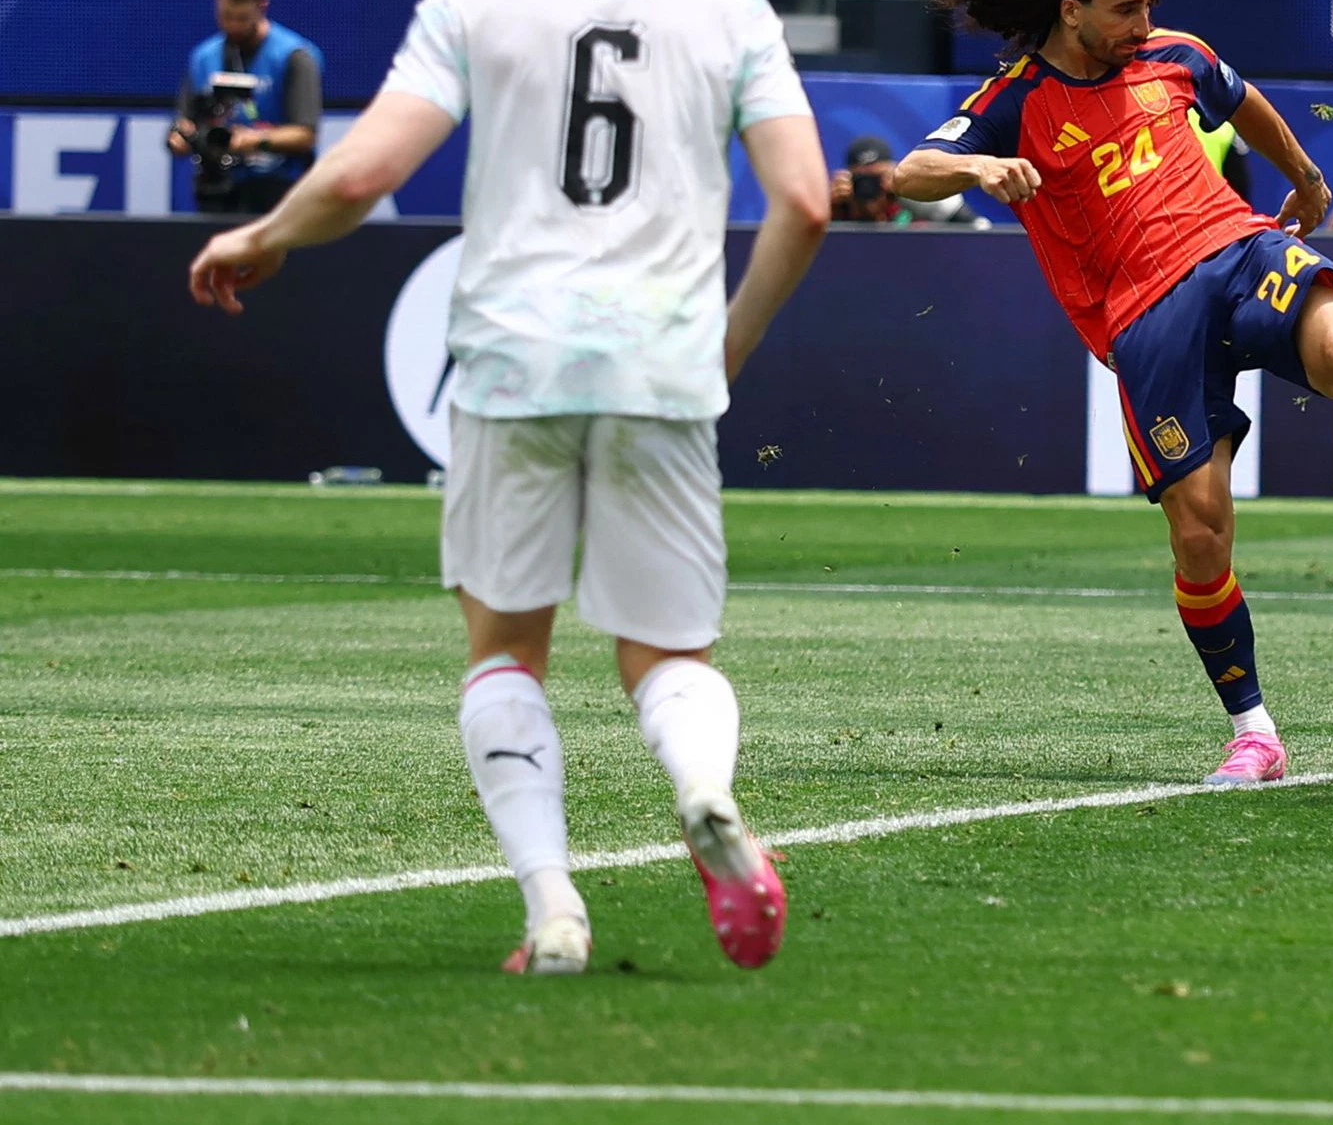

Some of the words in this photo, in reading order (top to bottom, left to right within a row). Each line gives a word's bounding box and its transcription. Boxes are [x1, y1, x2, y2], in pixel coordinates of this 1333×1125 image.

[558, 19, 650, 215] 6
[1091, 125, 1164, 198] 24
[1257, 244, 1321, 314] 24
